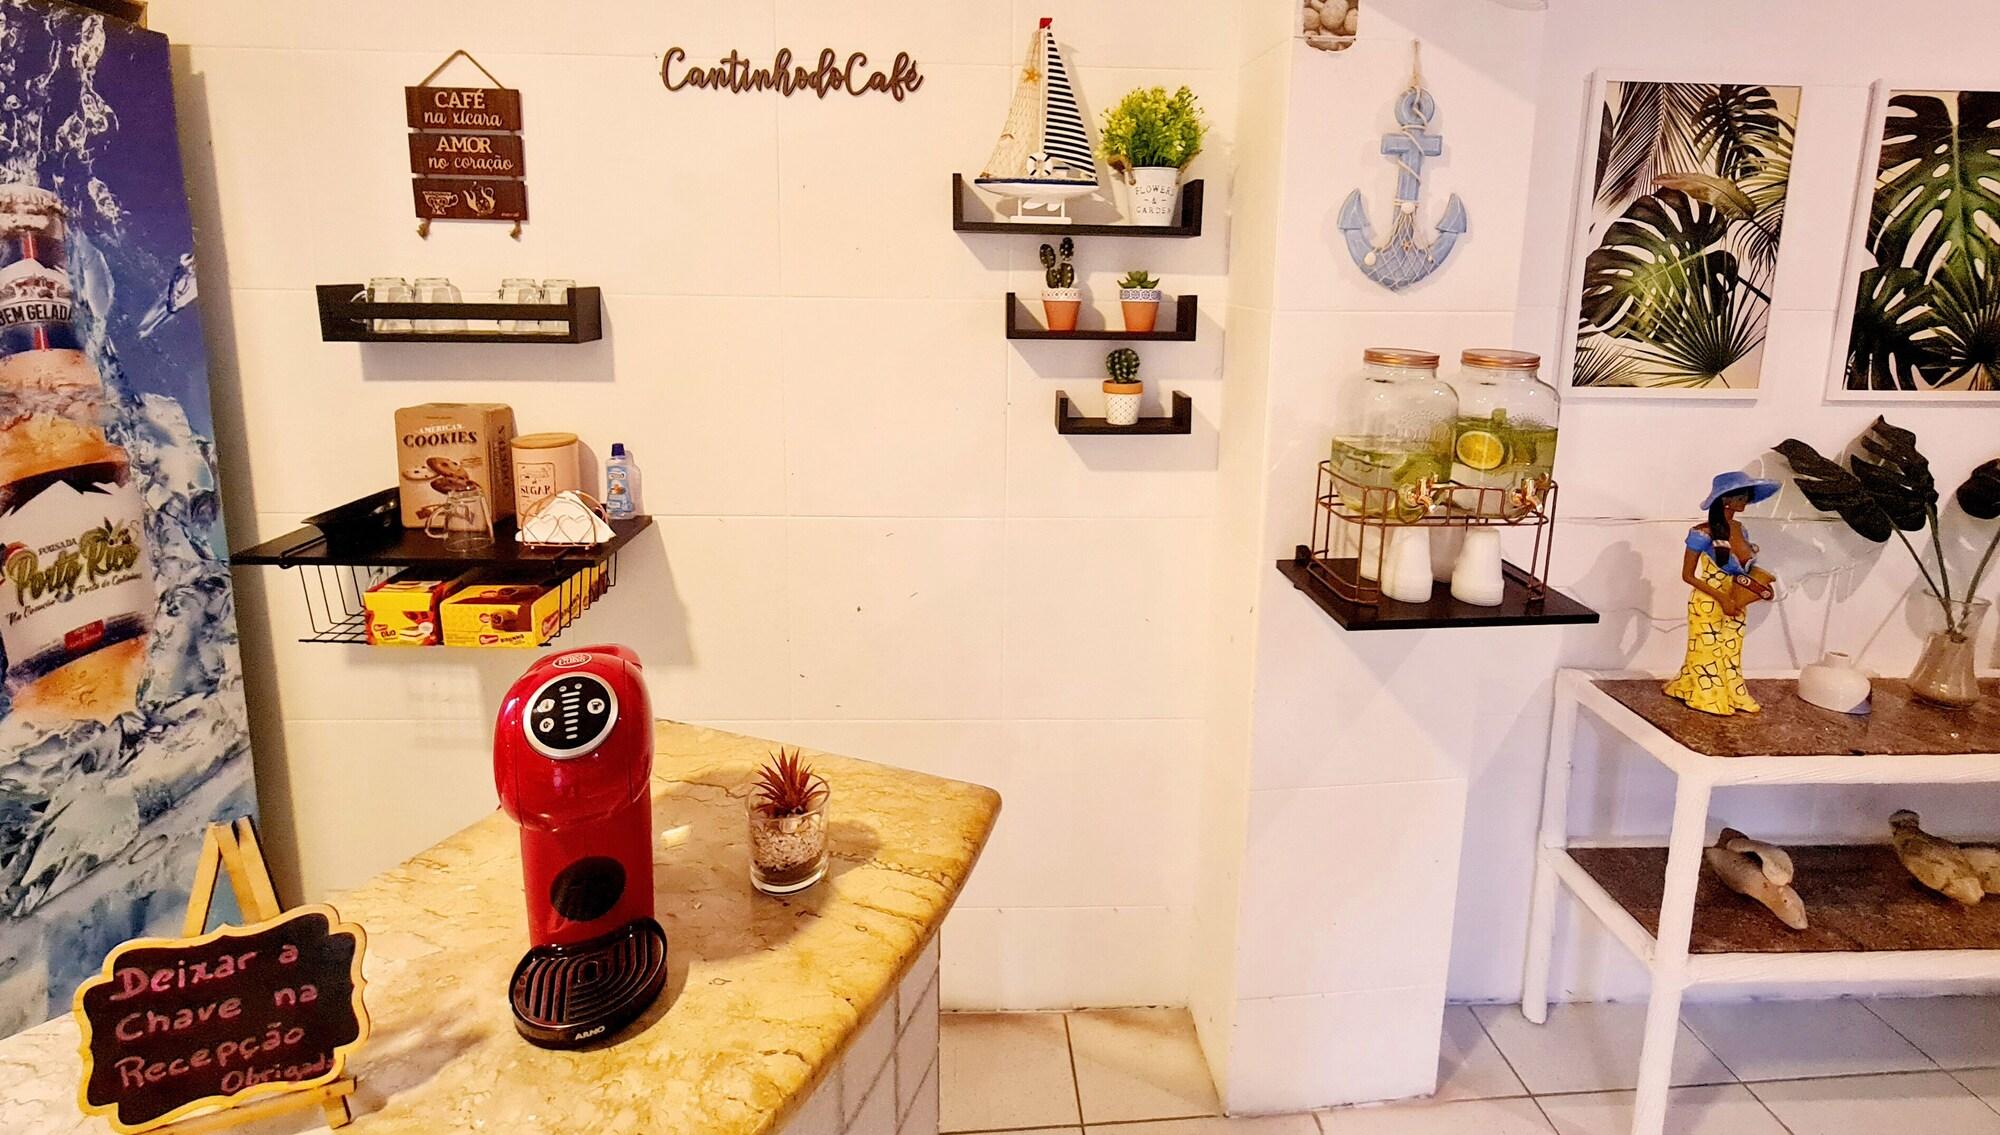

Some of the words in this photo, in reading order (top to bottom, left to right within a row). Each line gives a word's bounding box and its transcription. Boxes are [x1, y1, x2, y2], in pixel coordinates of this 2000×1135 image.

[434, 89, 485, 109] CAFÉ
[424, 111, 447, 124] na
[453, 110, 503, 127] xícara
[436, 136, 492, 154] AMOR
[428, 157, 450, 169] no
[454, 155, 514, 172] coração
[402, 431, 477, 448] COOKIES
[109, 952, 257, 1000] Deixar
[278, 944, 298, 964] a
[115, 997, 242, 1041] Chave
[273, 984, 318, 1006] na
[575, 1025, 606, 1041] ARNO
[114, 1022, 304, 1088] Recepção
